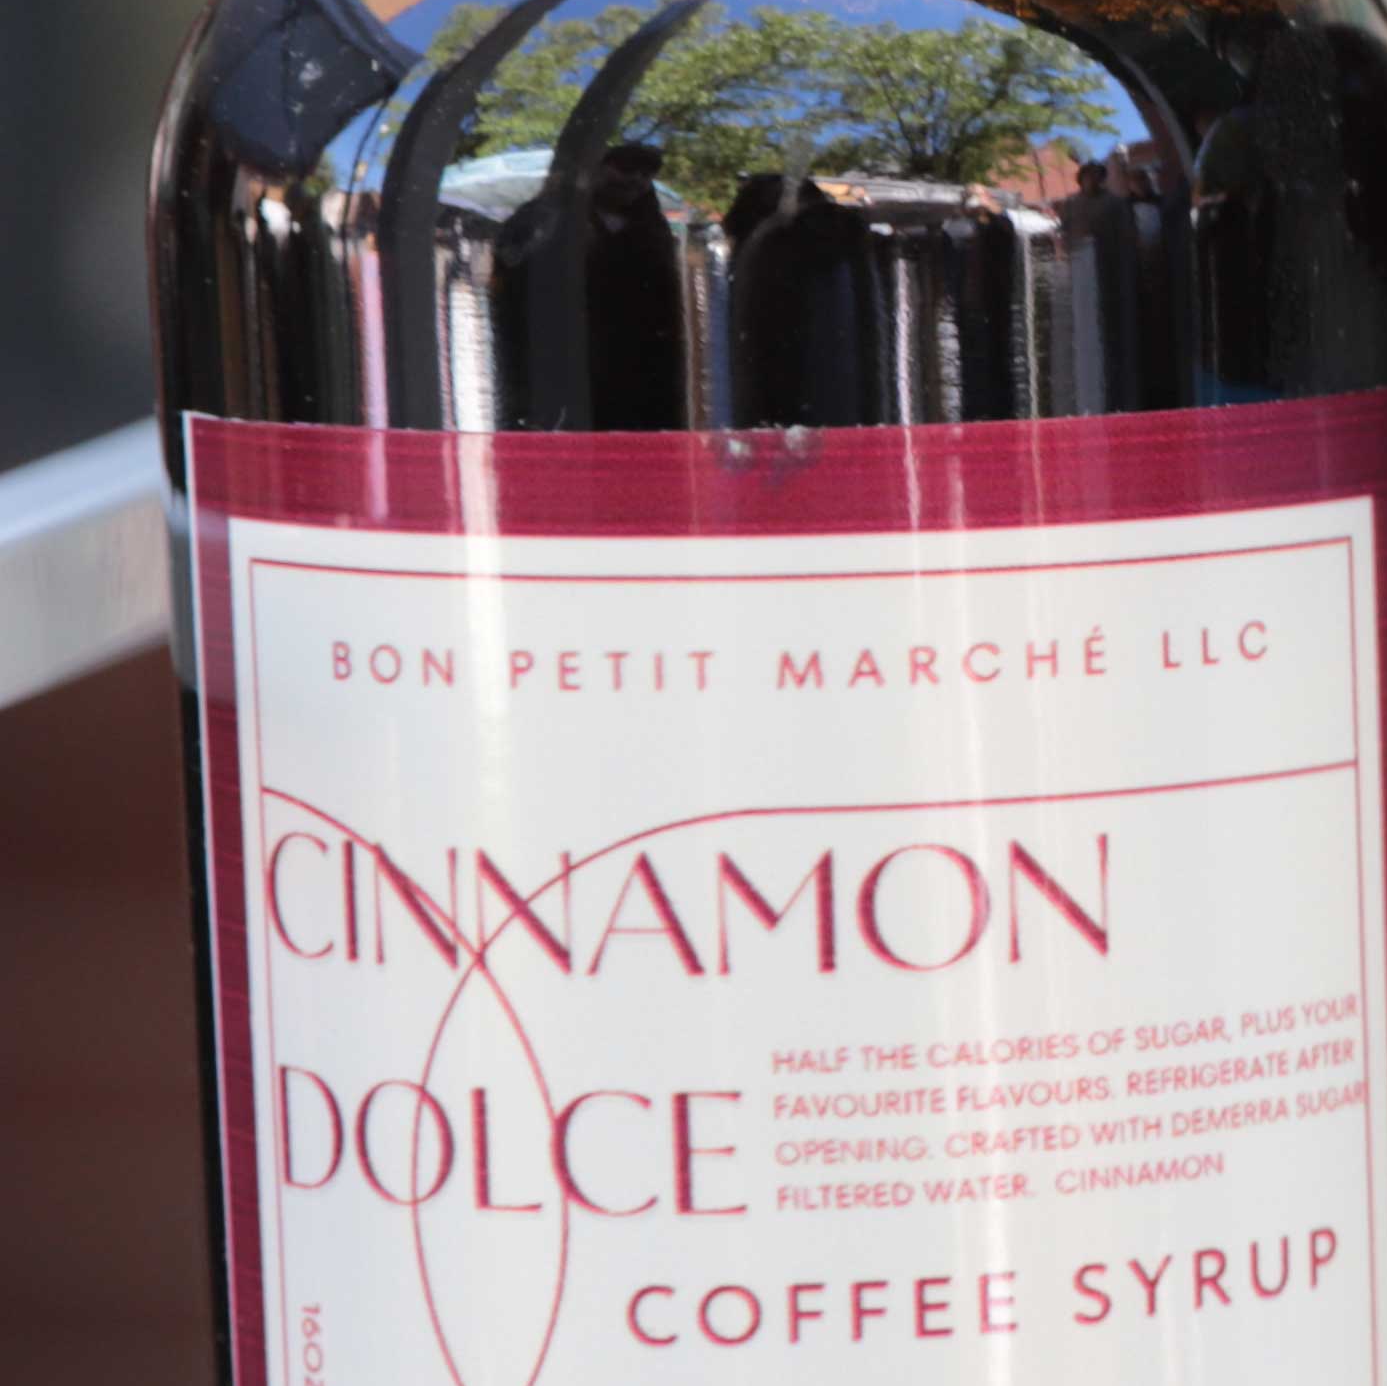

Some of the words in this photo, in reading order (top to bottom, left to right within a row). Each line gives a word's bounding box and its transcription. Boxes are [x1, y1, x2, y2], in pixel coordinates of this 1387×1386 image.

[333, 642, 456, 688] BON
[510, 649, 715, 691] PETIT
[777, 626, 1107, 689] MARCHÉ
[1163, 621, 1268, 670] LLC
[267, 832, 1108, 976] CINNAMON
[772, 1046, 849, 1075] HALF
[860, 1043, 917, 1072] THE
[927, 1033, 1079, 1069] CALORIES
[1087, 1027, 1125, 1056] OF
[1241, 1005, 1295, 1037] PLUS
[1302, 993, 1358, 1026] YOUR
[774, 1088, 946, 1120] FAVOURITE
[1127, 1050, 1288, 1097] REFRIGERATE
[1296, 1039, 1355, 1072] AFTER
[944, 1124, 1081, 1158] CRAFTED
[1091, 1114, 1163, 1145] WITH
[1171, 1097, 1289, 1137] DEMERRA
[1296, 1080, 1367, 1118] SUGAR
[279, 1063, 748, 1217] DOLCE
[776, 1181, 915, 1210] FILTERED
[1055, 1152, 1225, 1195] CINNAMON
[627, 1272, 1018, 1346] COFFEE
[1072, 1226, 1338, 1326] SYRUP
